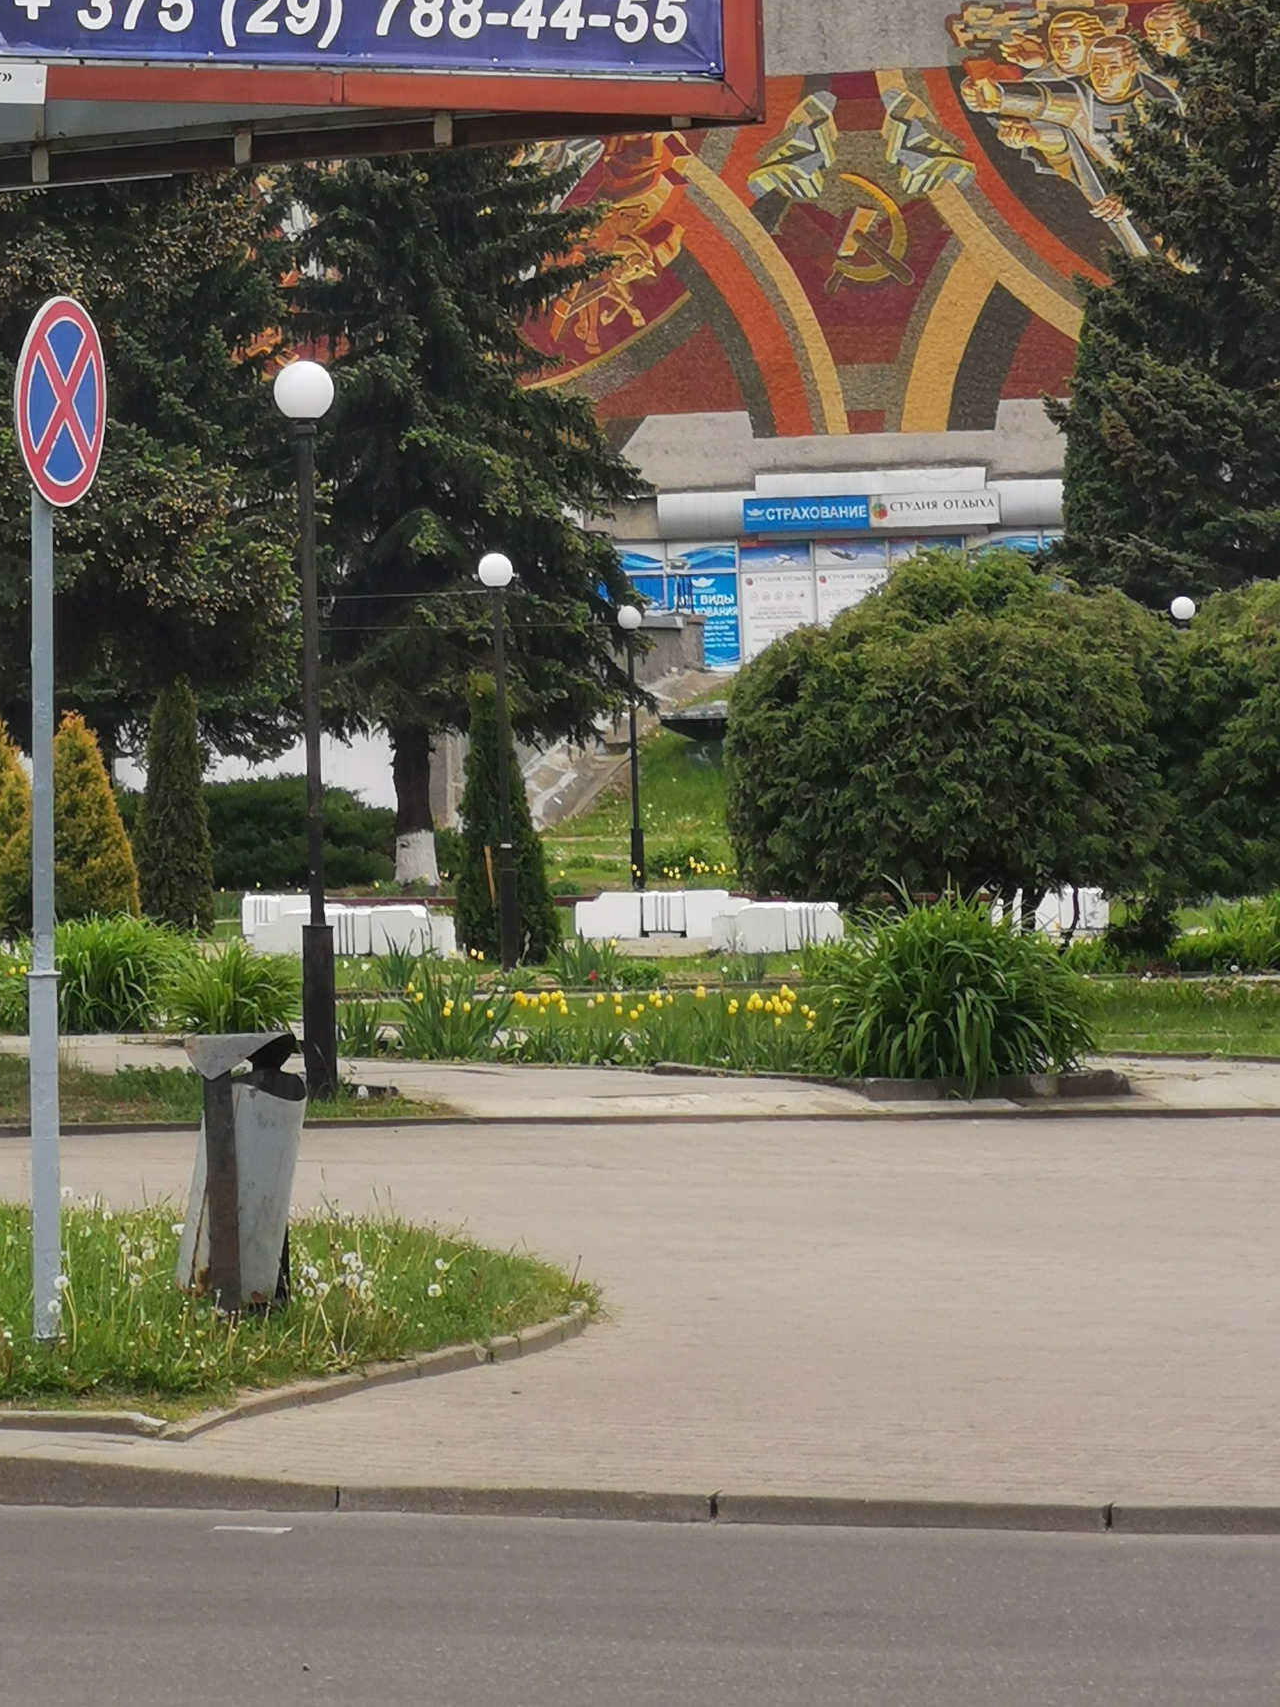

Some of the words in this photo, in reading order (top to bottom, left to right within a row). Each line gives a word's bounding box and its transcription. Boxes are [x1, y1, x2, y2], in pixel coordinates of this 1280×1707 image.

[890, 500, 938, 512] СТУДИЯ
[943, 498, 995, 509] ОТДЫХА
[765, 504, 868, 521] СТРАХОВАНИЕ
[700, 593, 735, 606] ВИДЫ
